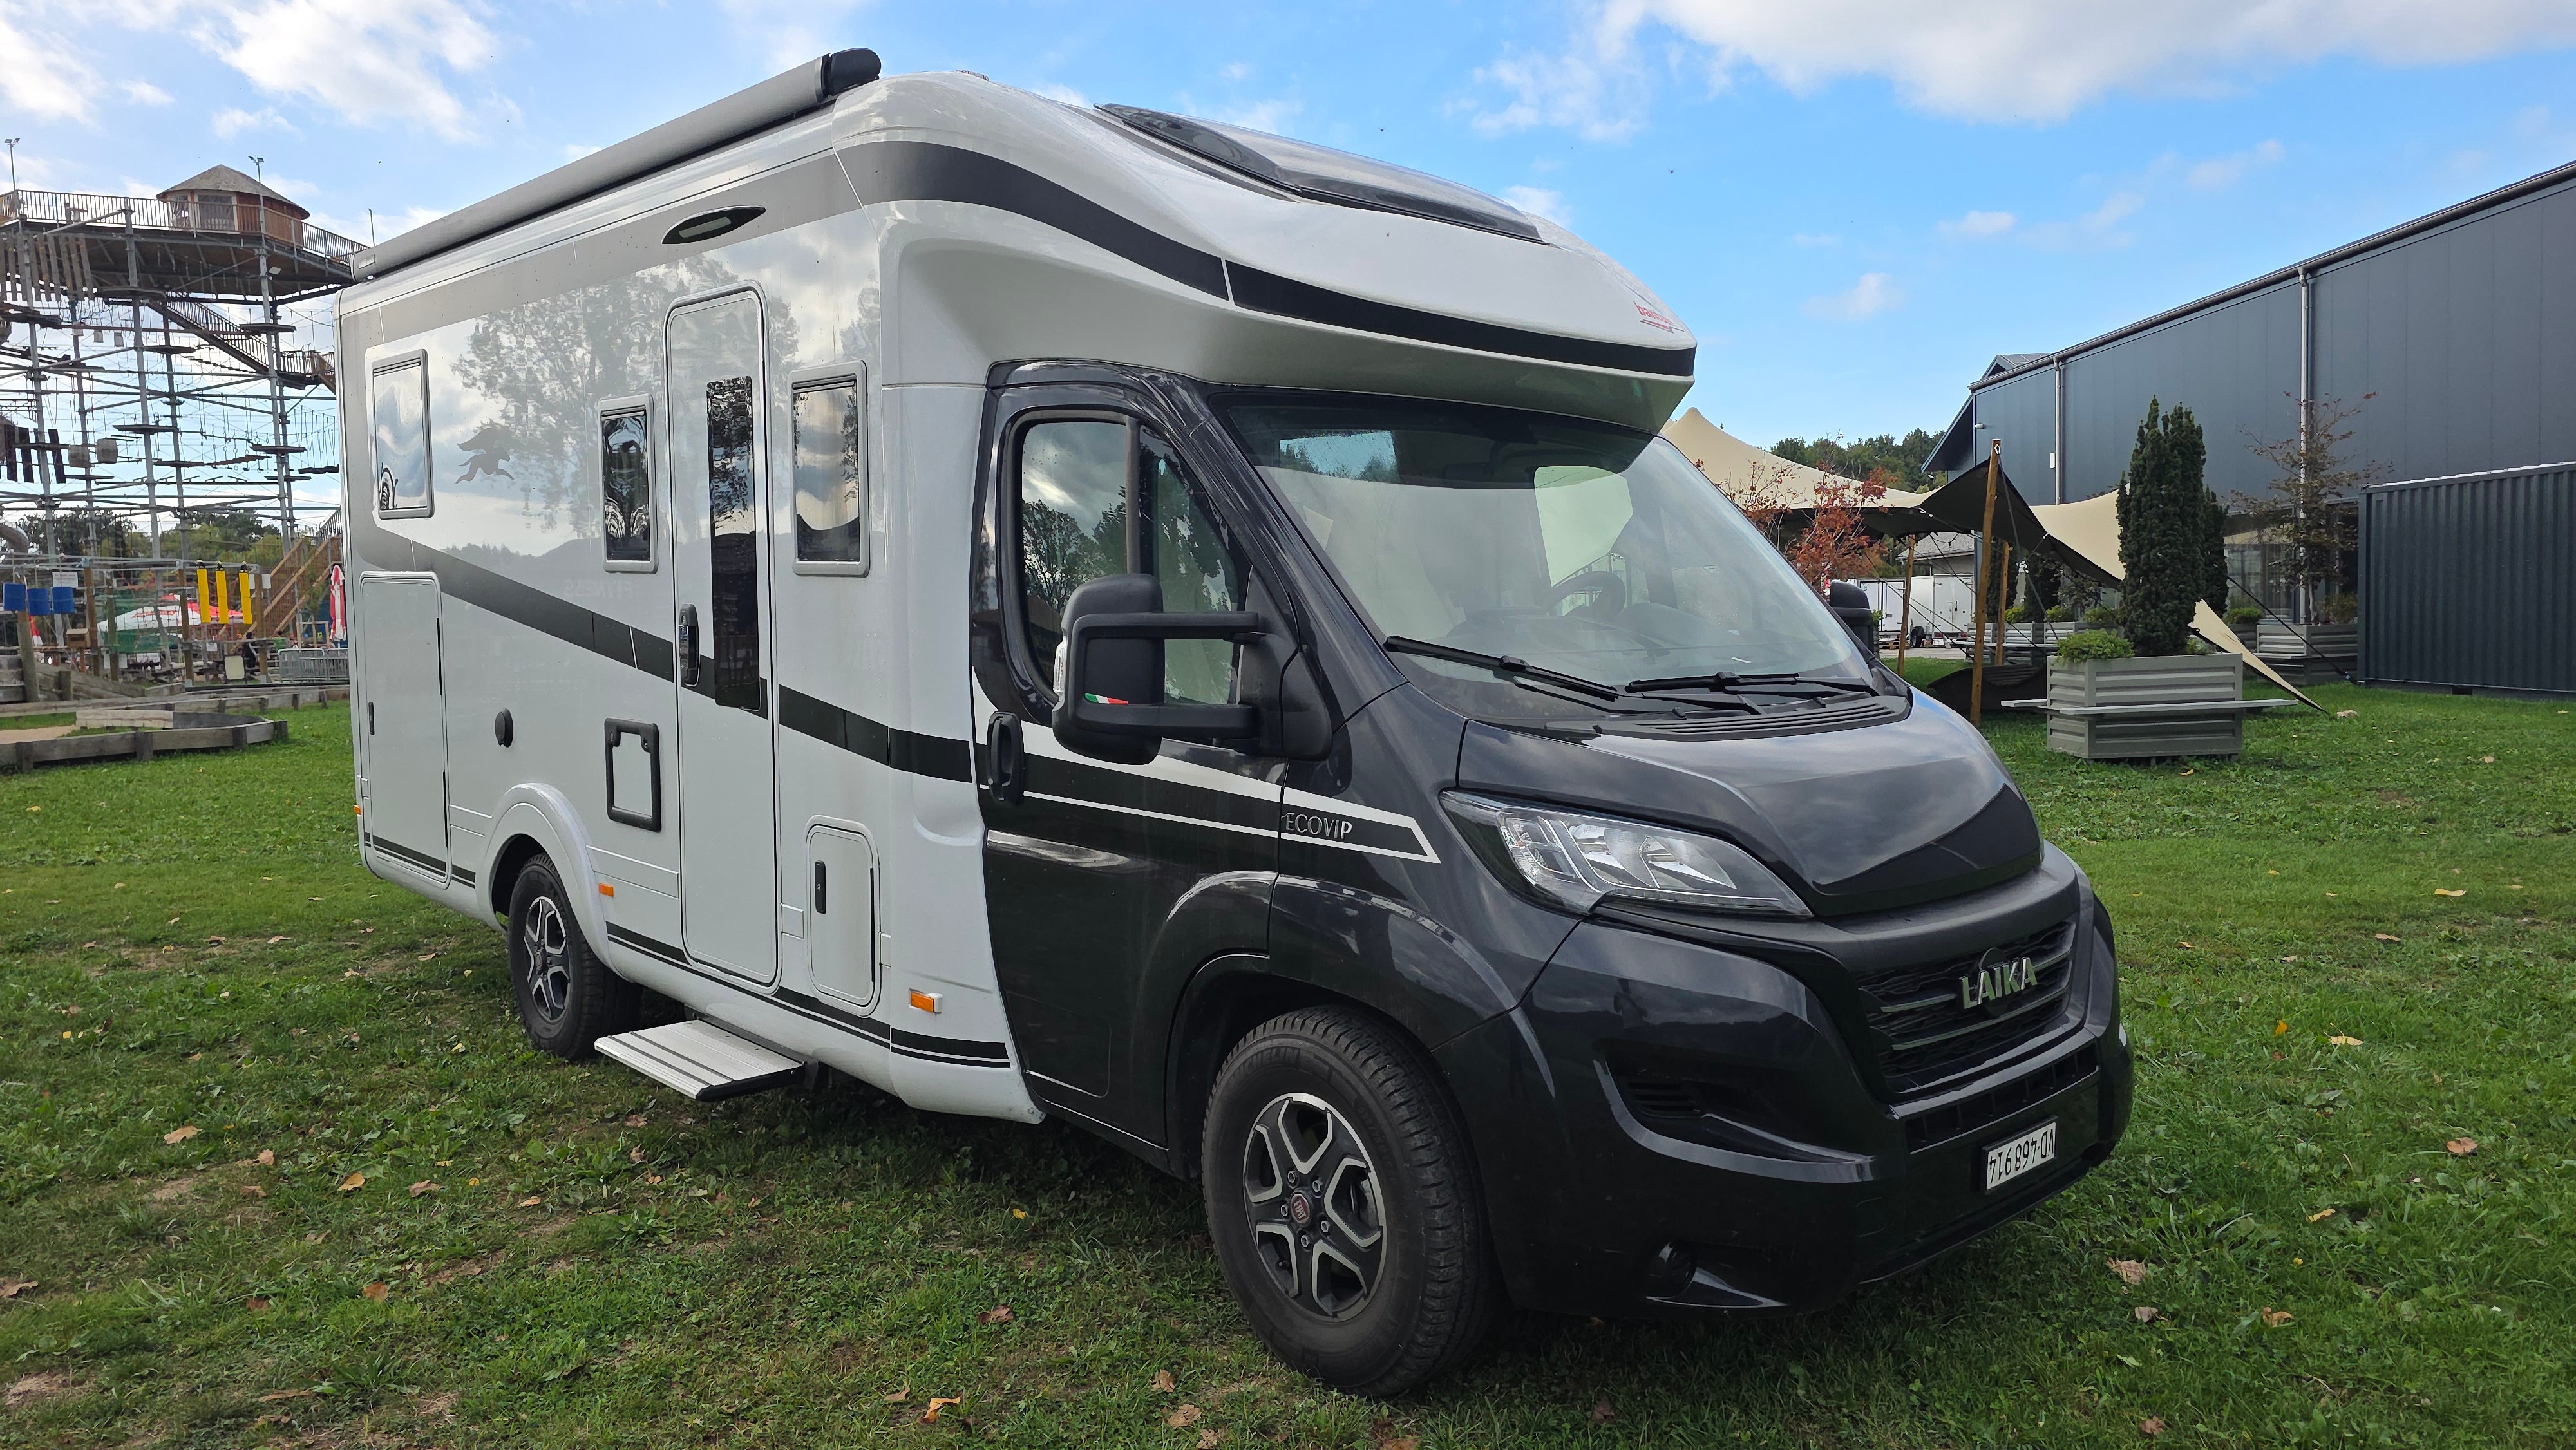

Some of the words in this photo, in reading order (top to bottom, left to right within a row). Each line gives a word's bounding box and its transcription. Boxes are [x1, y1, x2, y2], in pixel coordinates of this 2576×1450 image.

[1281, 812, 1352, 840] ECOVIP
[1958, 957, 2038, 1010] LAIKA
[1293, 1200, 1307, 1219] FIAT
